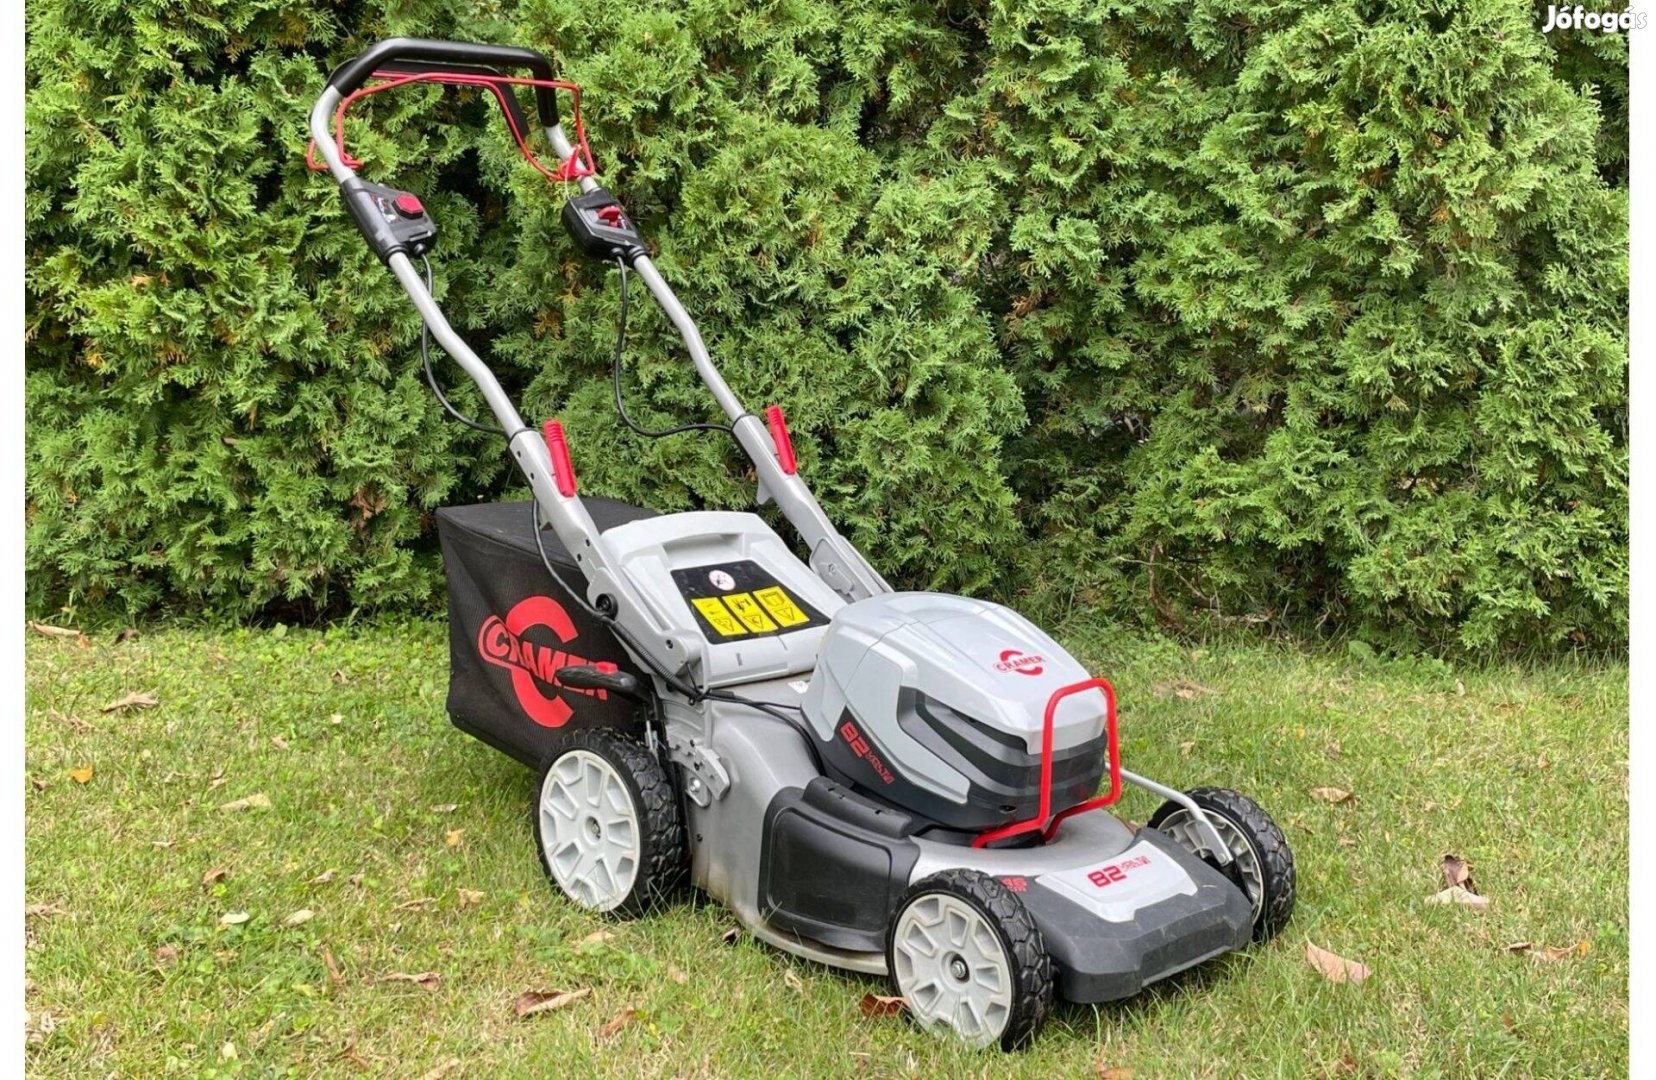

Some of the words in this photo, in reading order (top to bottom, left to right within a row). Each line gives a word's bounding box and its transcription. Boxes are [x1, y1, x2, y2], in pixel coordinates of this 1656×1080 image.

[478, 614, 609, 701] CRAM
[840, 721, 871, 758] 82
[1087, 865, 1128, 888] 82
